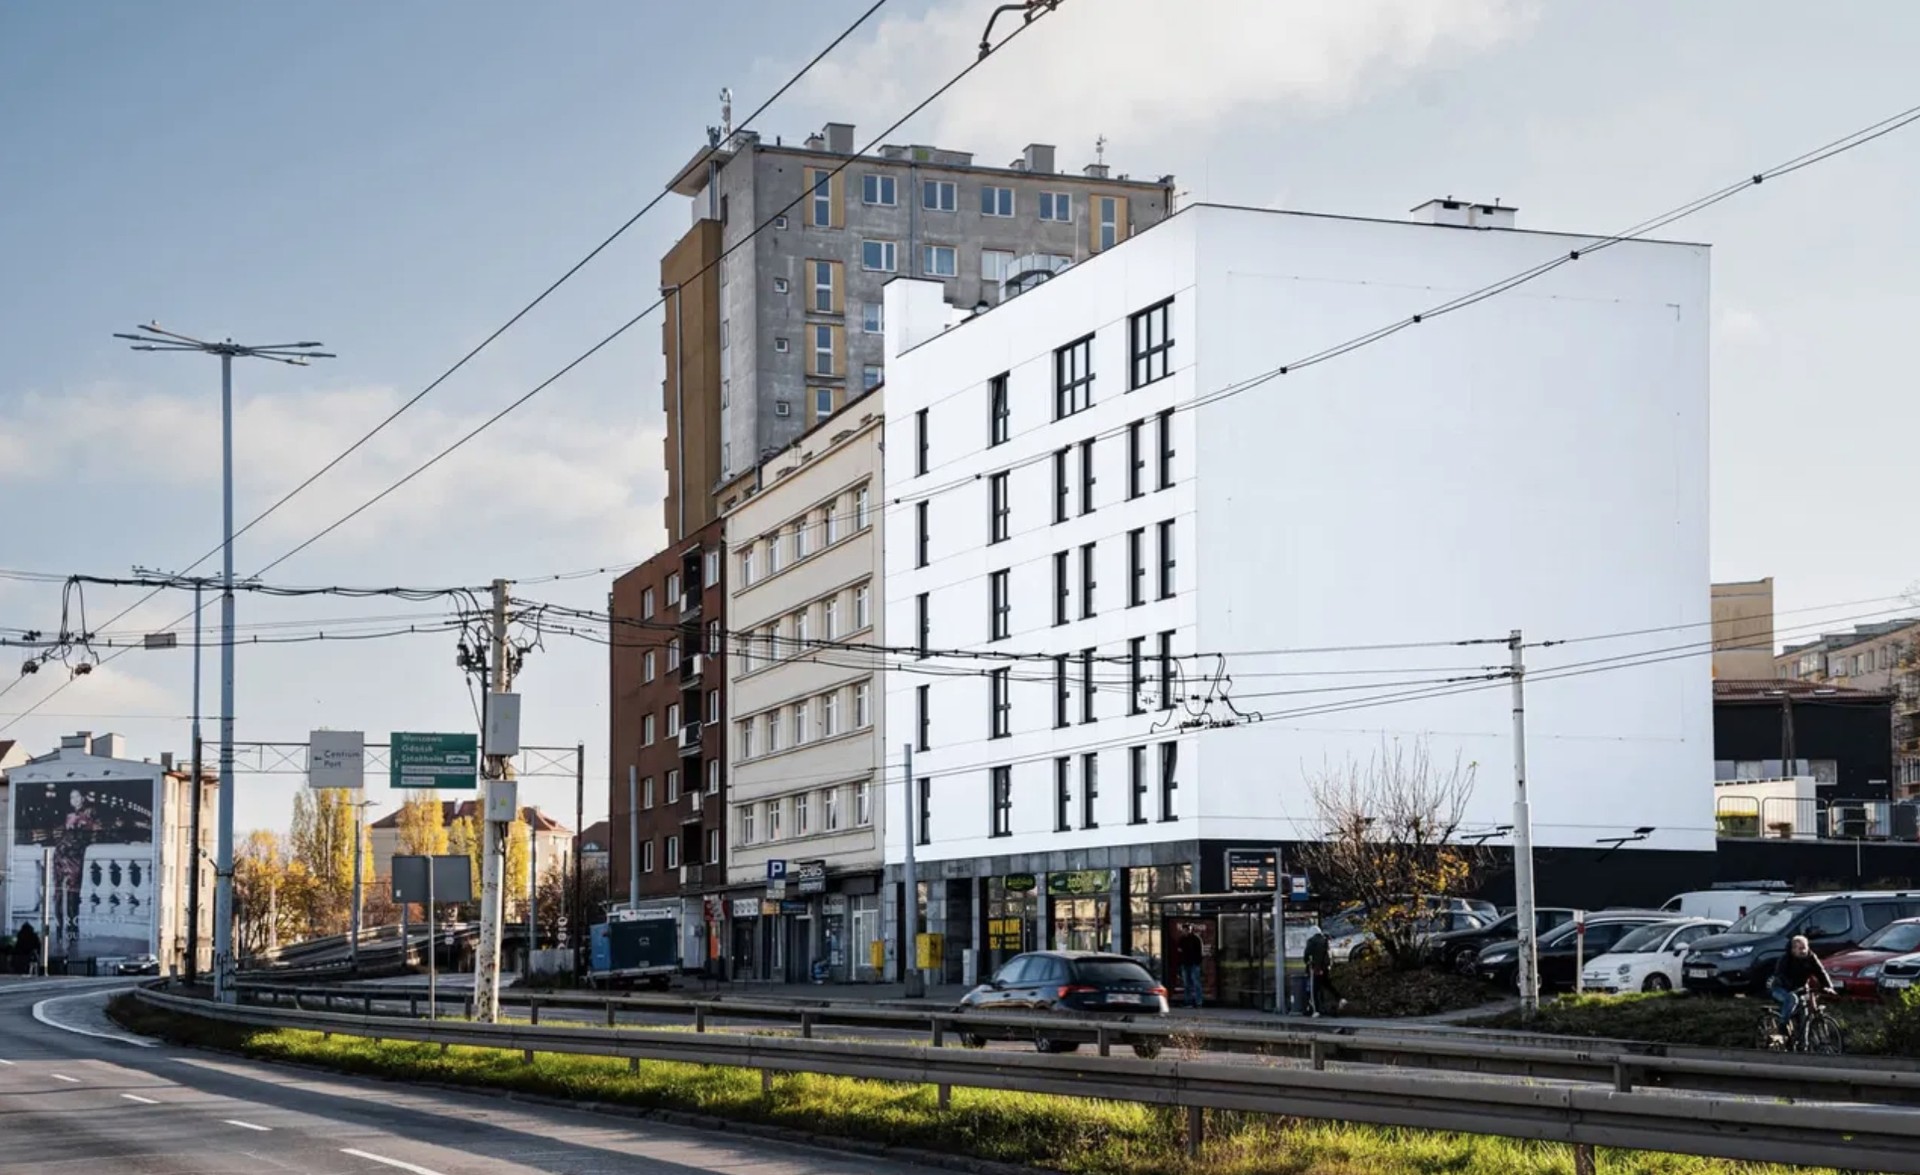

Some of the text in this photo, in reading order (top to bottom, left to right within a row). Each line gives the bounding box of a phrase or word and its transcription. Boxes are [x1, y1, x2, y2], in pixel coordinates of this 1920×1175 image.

[324, 750, 361, 758] Centrum
[324, 760, 341, 768] Port
[771, 862, 783, 877] P
